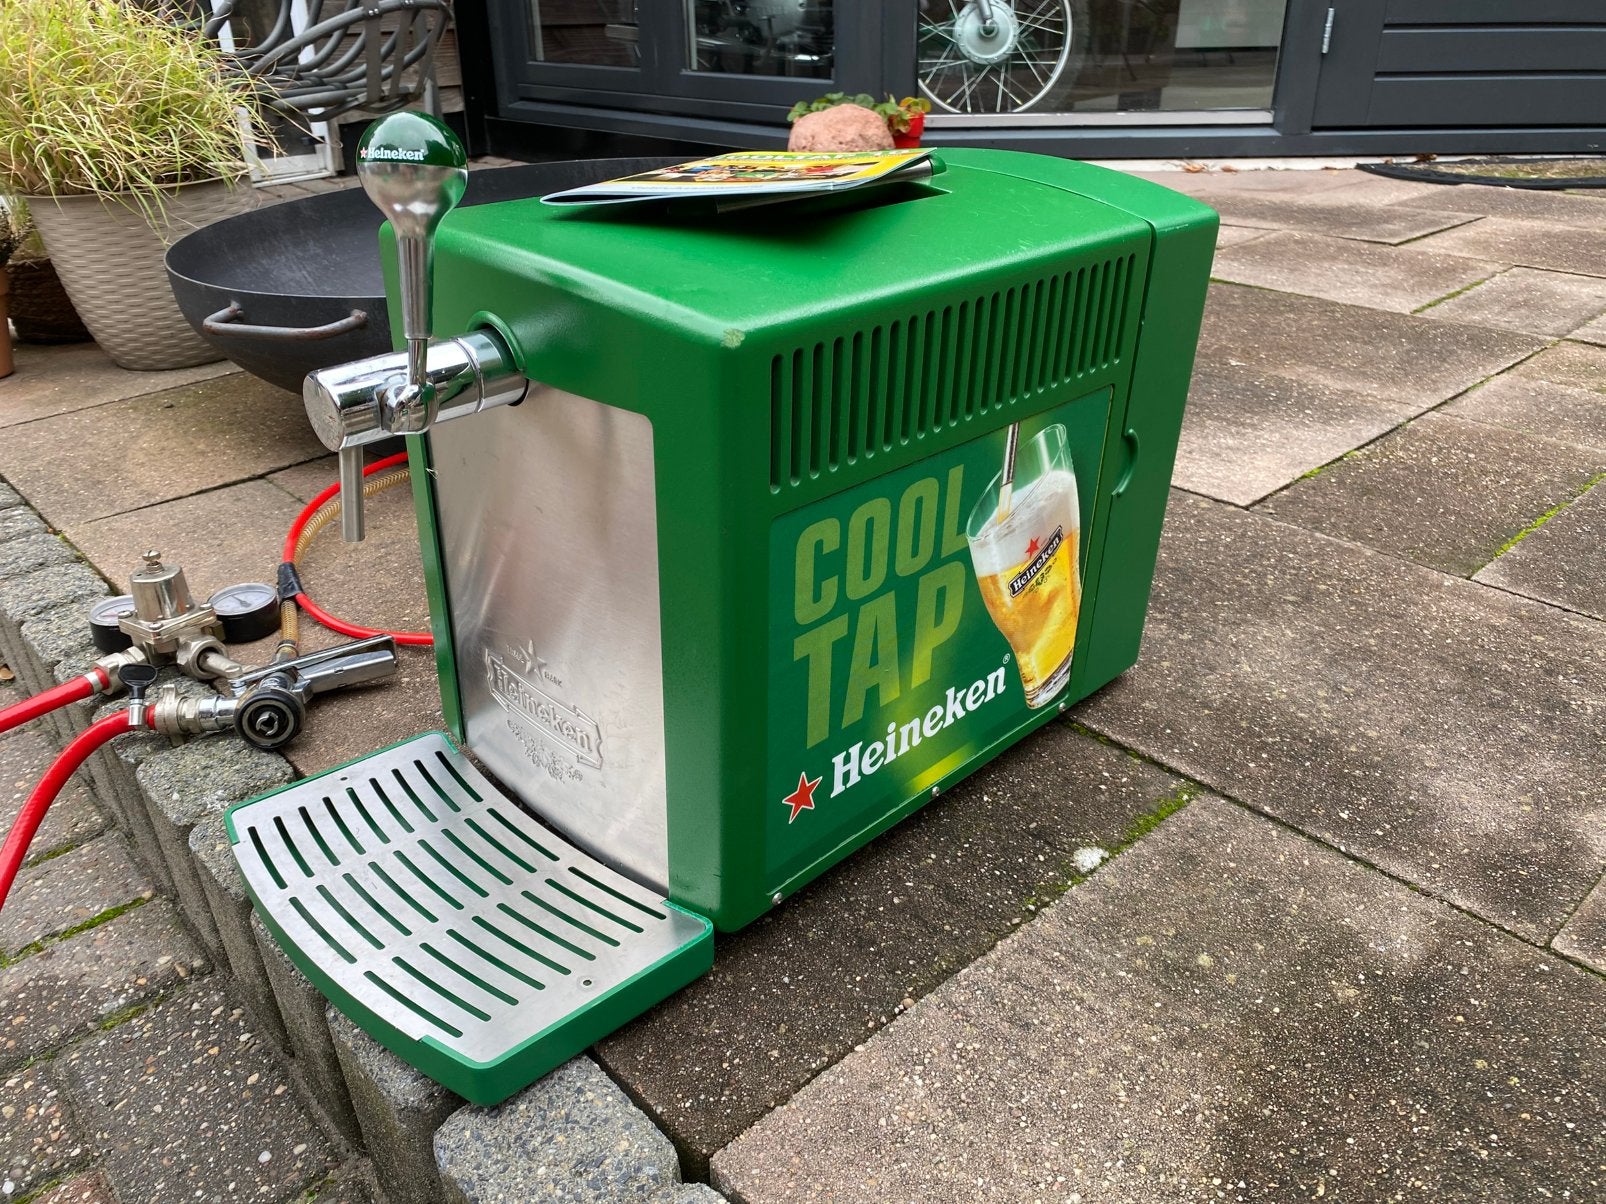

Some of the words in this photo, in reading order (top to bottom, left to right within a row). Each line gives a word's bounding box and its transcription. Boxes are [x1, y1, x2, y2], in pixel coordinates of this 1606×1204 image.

[367, 147, 425, 161] Heineken
[793, 463, 969, 625] COOL
[1013, 536, 1060, 592] Heineken
[793, 561, 966, 750] TAP
[494, 663, 592, 752] Heineken
